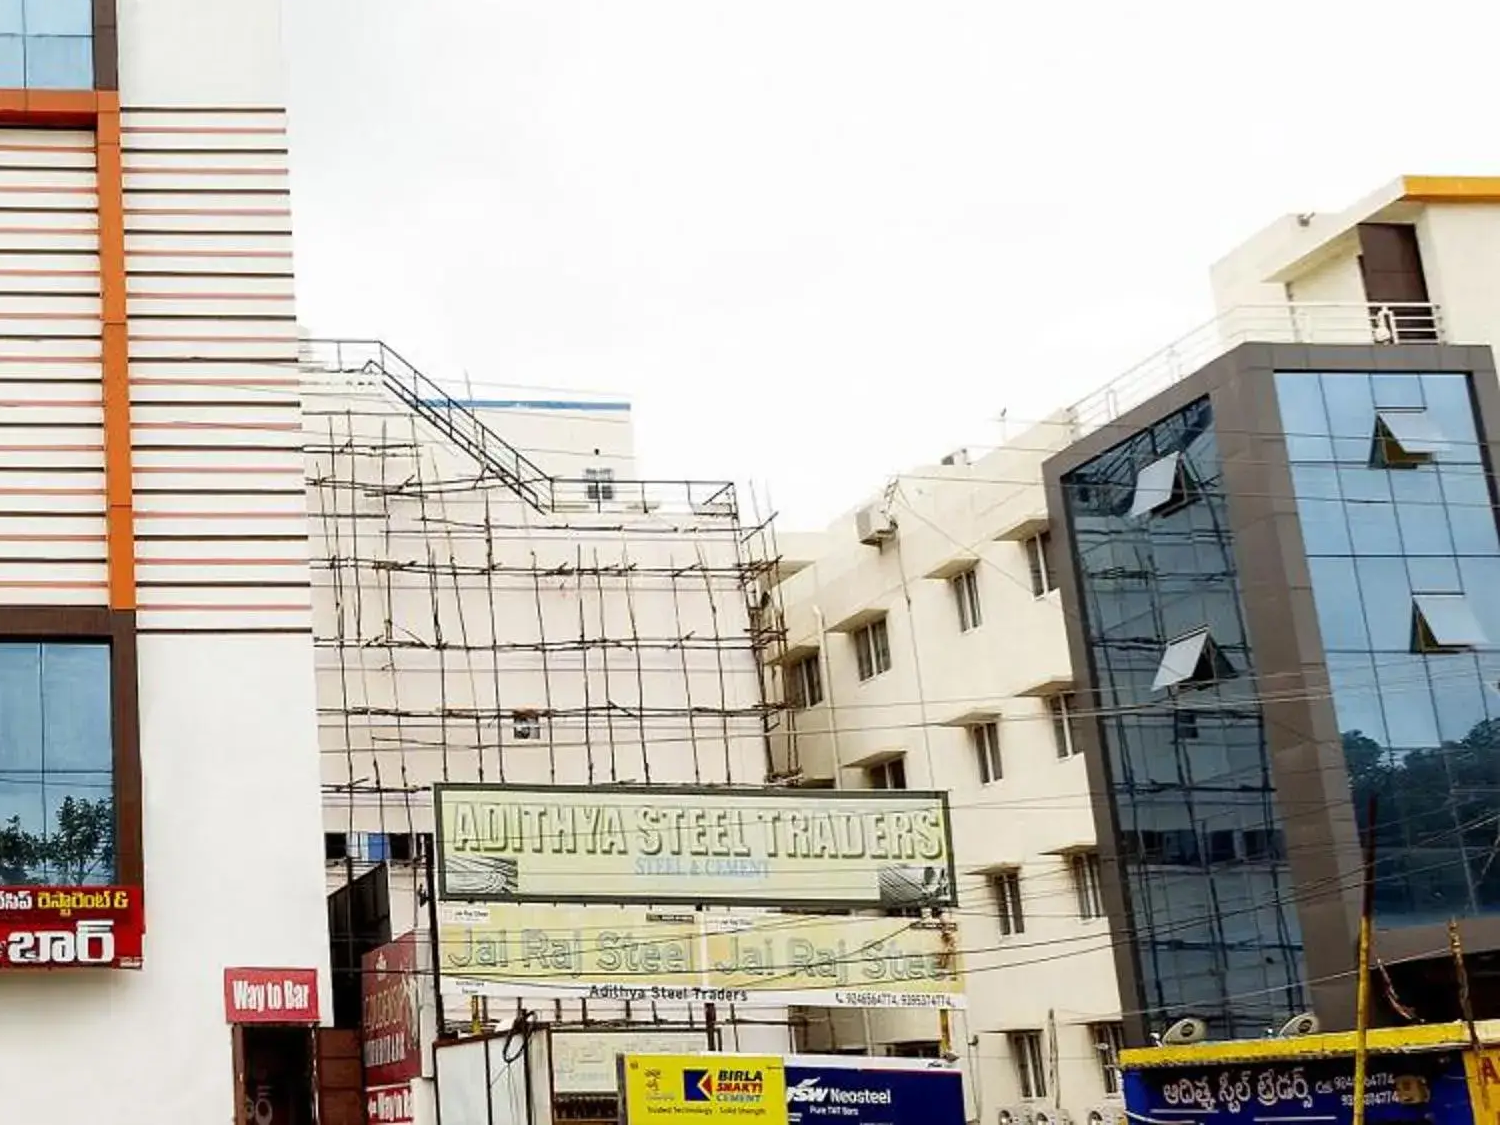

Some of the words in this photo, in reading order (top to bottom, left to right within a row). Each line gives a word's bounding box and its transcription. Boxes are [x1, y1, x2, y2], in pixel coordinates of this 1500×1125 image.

[454, 803, 628, 855] ADITHYA
[635, 805, 752, 857] STEEL
[757, 807, 944, 860] TRADERS
[447, 929, 509, 968] Jai
[520, 928, 582, 979] Raj
[595, 931, 694, 973] Steel
[712, 936, 775, 976] Jai
[787, 936, 850, 985] Raj
[233, 979, 264, 1012] Way
[266, 980, 282, 1010] to
[284, 979, 309, 1010] Bar
[589, 985, 646, 1001] Adithya
[651, 985, 689, 1000] Steel
[692, 986, 748, 1001] Traders
[717, 1070, 763, 1082] BIRLA
[716, 1081, 763, 1093] SHAKTI
[716, 1093, 762, 1103] CEMENT
[830, 1088, 892, 1104] Neosteel
